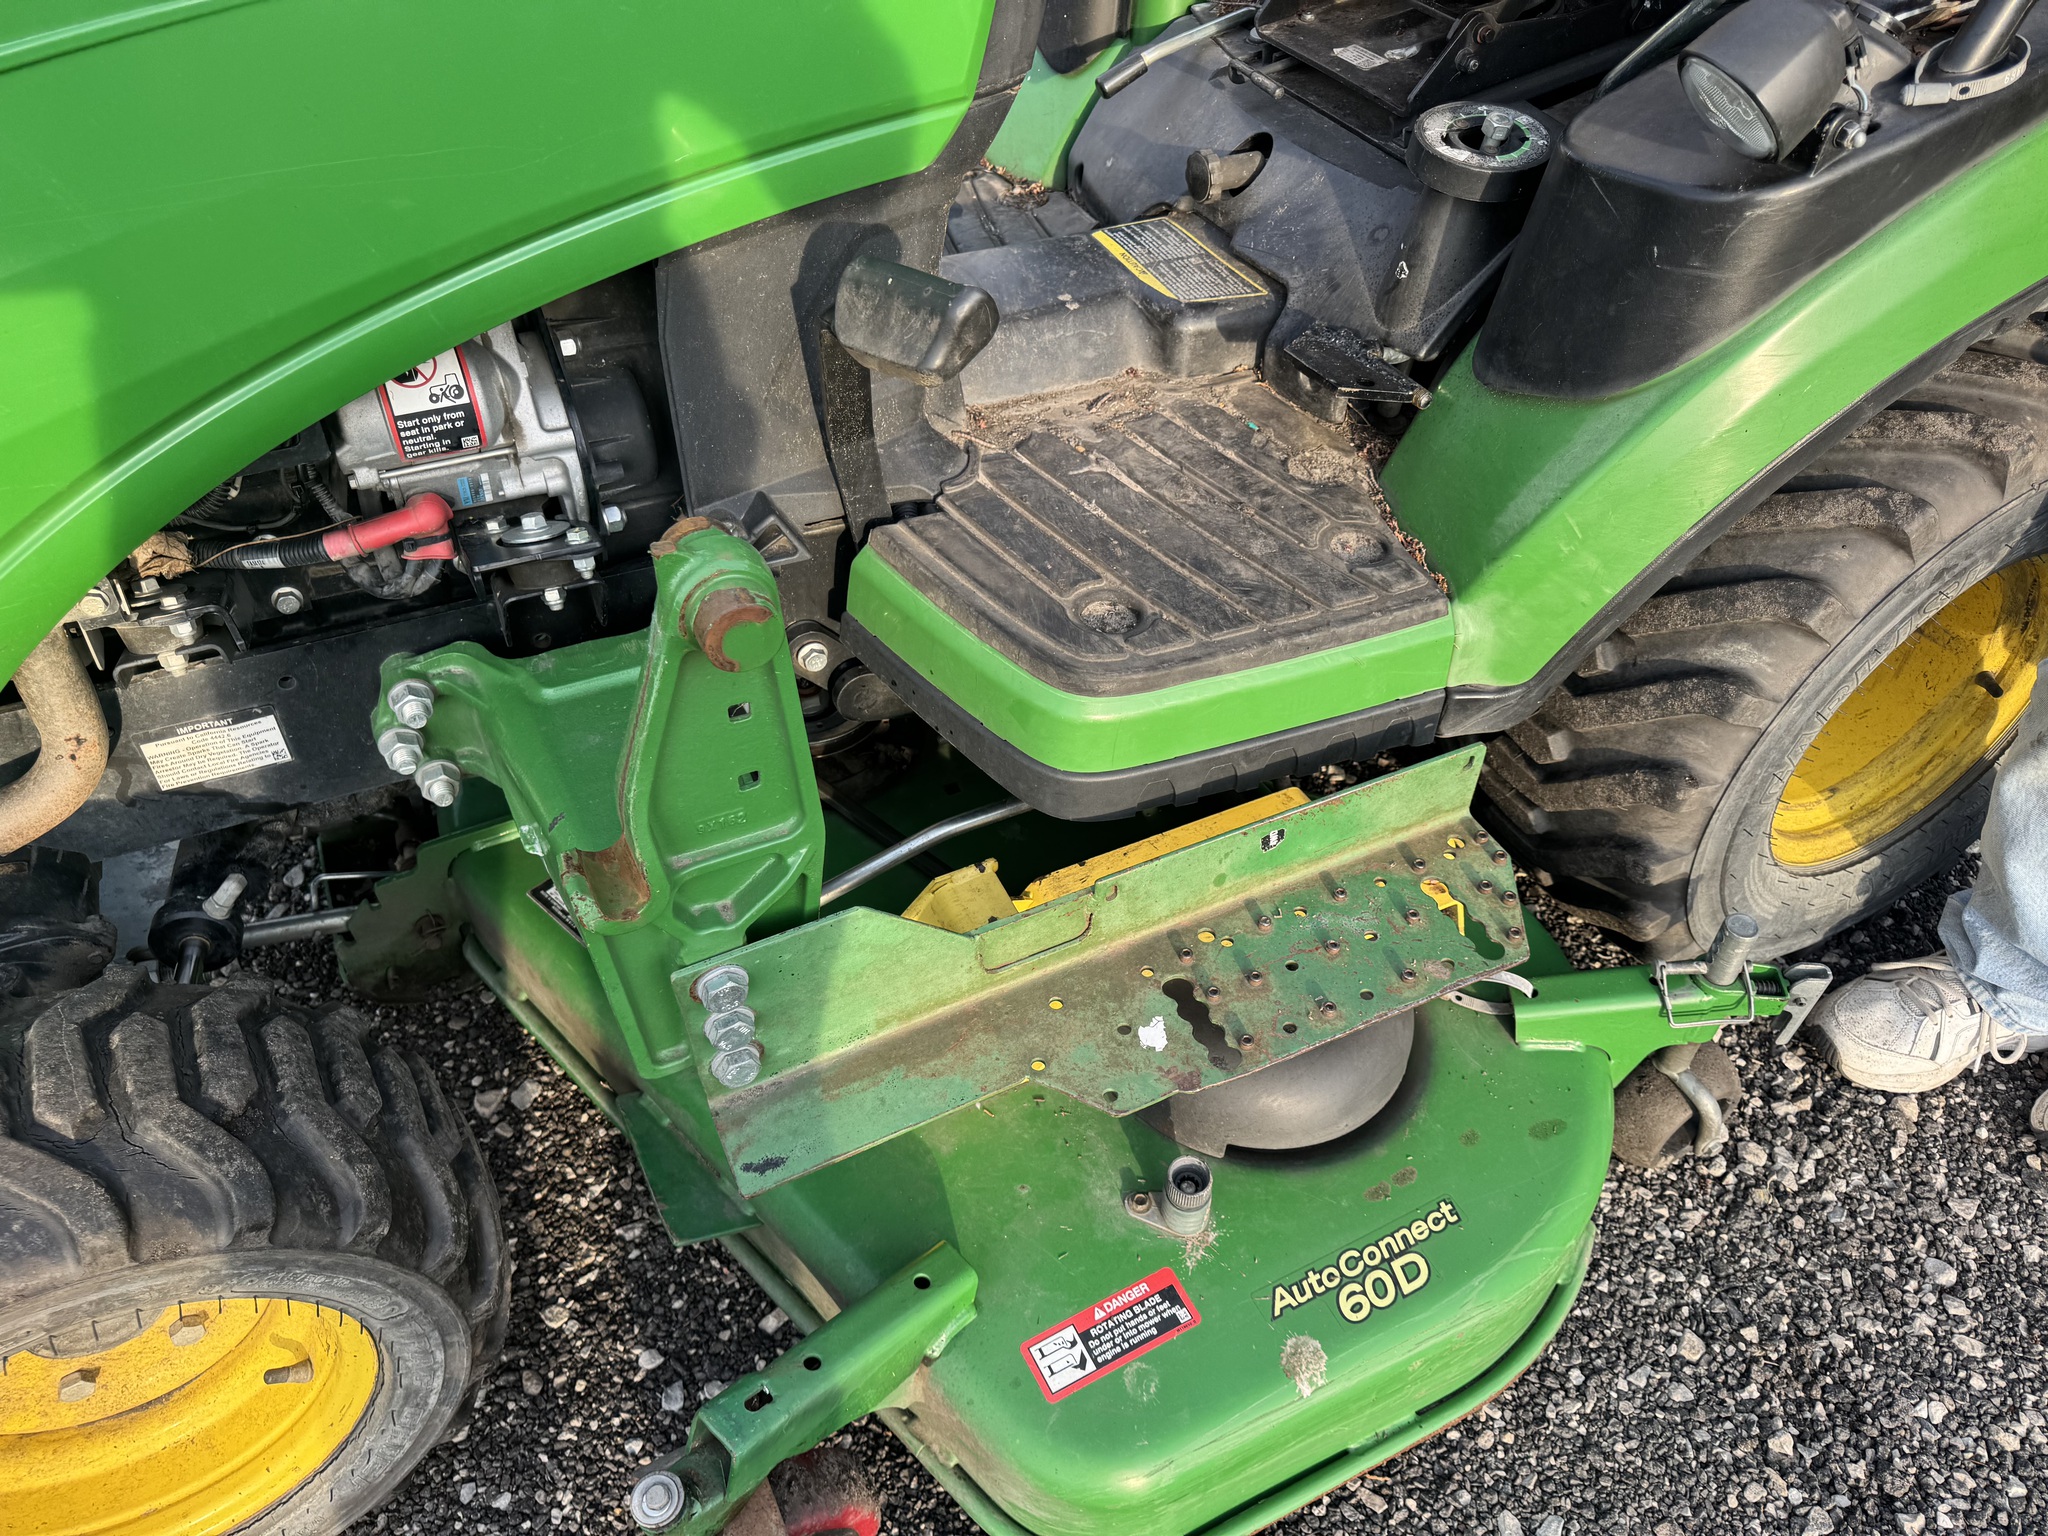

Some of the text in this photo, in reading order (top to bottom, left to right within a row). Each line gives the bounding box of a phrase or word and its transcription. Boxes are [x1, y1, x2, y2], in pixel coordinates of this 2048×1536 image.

[397, 409, 464, 428] Start only from
[399, 427, 419, 437] seat
[421, 425, 430, 433] in
[432, 421, 453, 433] park
[402, 433, 436, 445] neutral.
[404, 440, 439, 453] Starting
[406, 445, 448, 458] gear kills.
[154, 737, 185, 748] Pursuant
[194, 727, 225, 739] California
[227, 719, 261, 732] Resources
[176, 717, 233, 735] IMPORTANT
[191, 737, 208, 745] Code
[147, 748, 180, 760] WARNING
[185, 739, 216, 752] Operation
[241, 725, 276, 738] Equipment
[149, 758, 164, 766] May
[164, 752, 186, 762] Create
[187, 747, 209, 757] Sparks
[211, 743, 225, 751] That
[240, 736, 256, 744] Start
[152, 762, 168, 770] Fires
[169, 756, 194, 766] Around
[195, 752, 209, 760] Dry
[250, 738, 268, 747] Spark
[154, 764, 181, 775] Arrestor
[251, 740, 279, 751] Operator
[157, 770, 180, 779] Should
[180, 763, 206, 773] Contact
[207, 759, 225, 767] Local
[239, 748, 269, 760] Agencies
[171, 773, 188, 781] Laws
[198, 762, 236, 775] Regulations
[237, 755, 263, 766] Relating
[175, 773, 210, 785] Prevention
[1271, 1201, 1461, 1323] AutoConnect
[1103, 1282, 1150, 1313] DANGER
[1337, 1251, 1431, 1324] 60D
[1088, 1299, 1170, 1349] Do not put hands or feet
[1089, 1293, 1162, 1337] ROTATING BLADE
[1092, 1339, 1114, 1355] under
[1114, 1335, 1123, 1344] or
[1122, 1326, 1137, 1339] into
[1137, 1315, 1161, 1331] mower
[1161, 1304, 1181, 1318] when
[1096, 1344, 1122, 1364] engine
[1121, 1340, 1129, 1350] is
[1128, 1325, 1157, 1347] running
